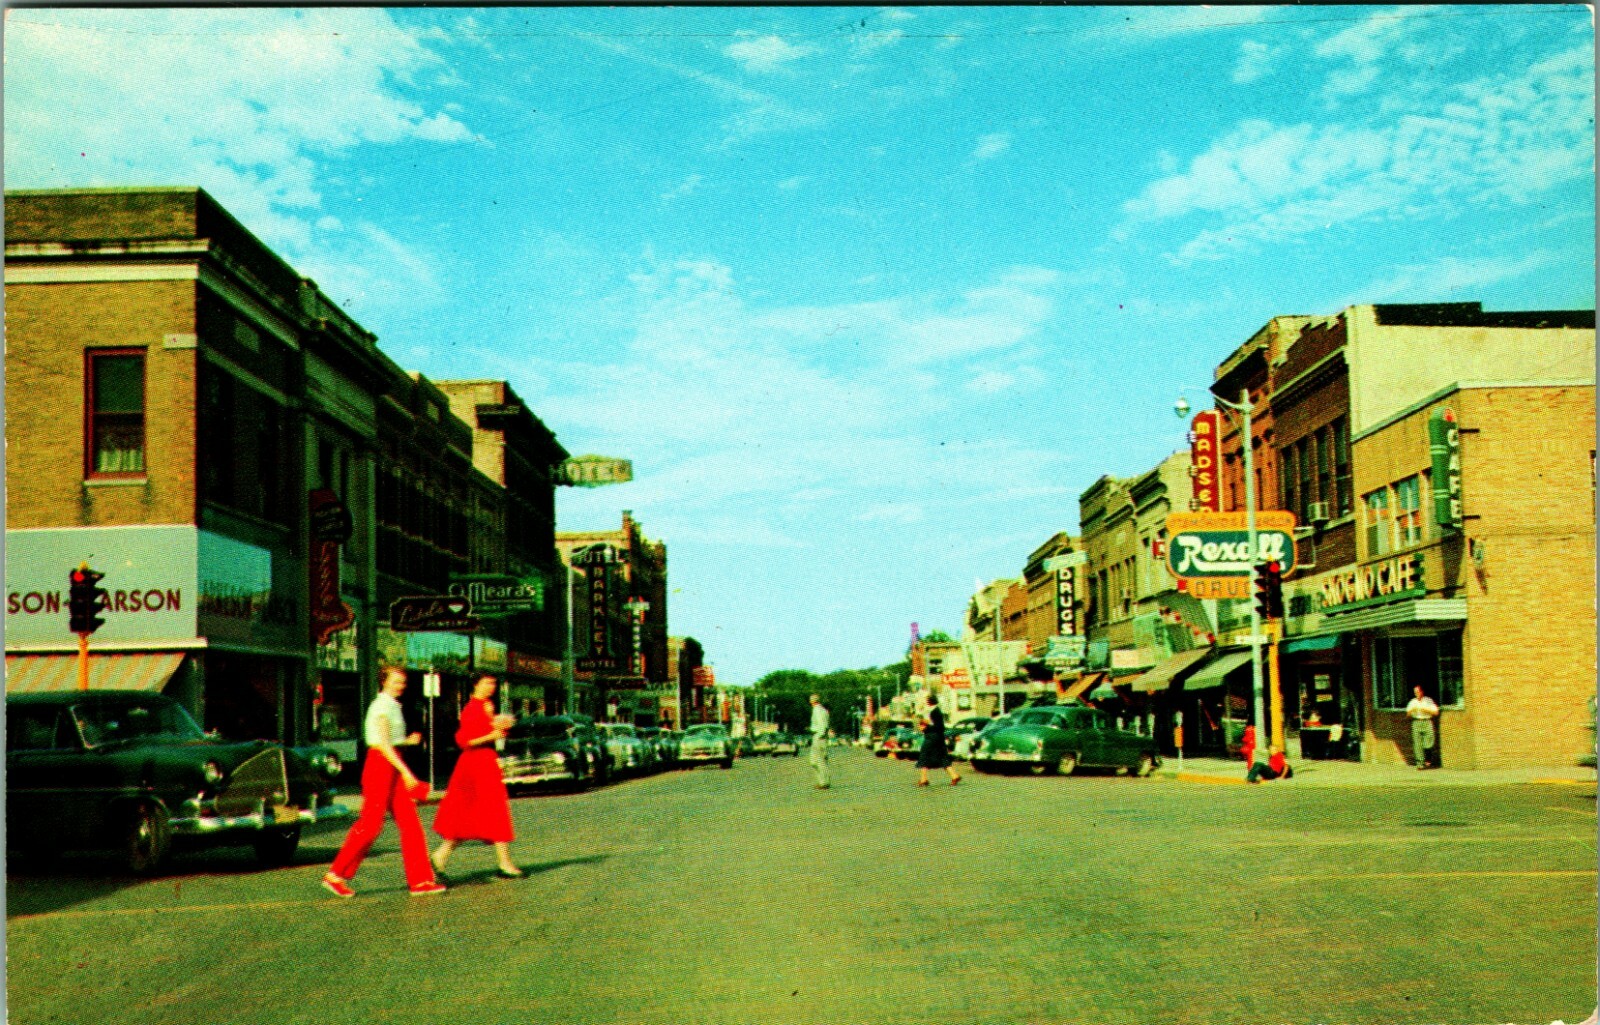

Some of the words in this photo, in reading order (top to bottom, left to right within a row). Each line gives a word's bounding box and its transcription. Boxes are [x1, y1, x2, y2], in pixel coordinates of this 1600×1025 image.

[549, 462, 629, 482] HOTEL
[1446, 428, 1461, 519] CAFE
[1176, 533, 1285, 573] Rexall
[1377, 558, 1416, 597] CAFE
[592, 566, 605, 656] BARKLEY
[1060, 567, 1074, 634] DRUGS
[581, 660, 616, 668] HOTEL
